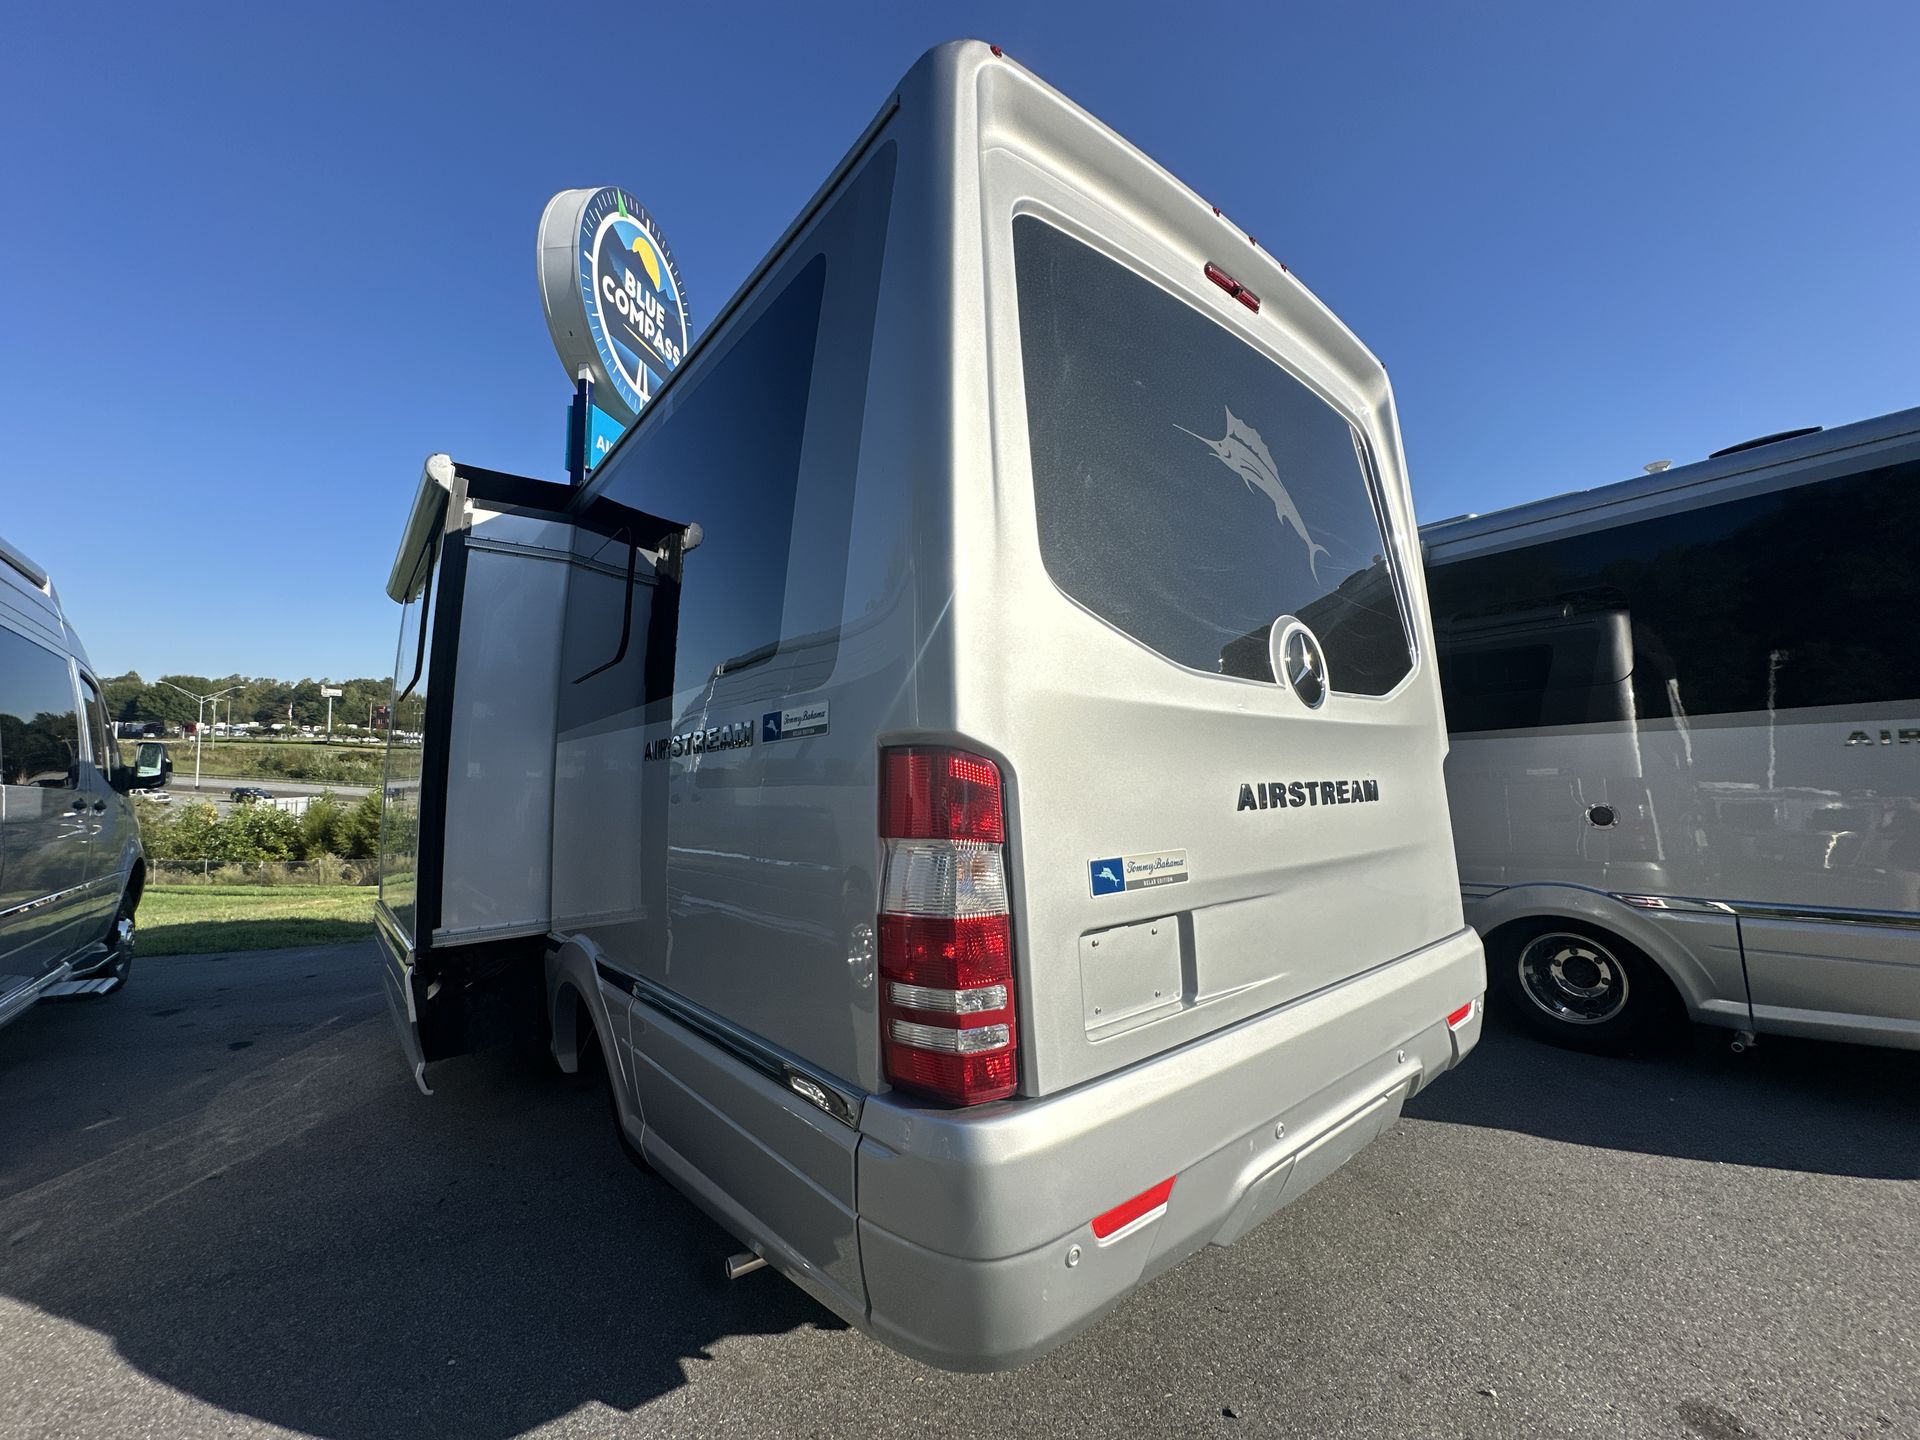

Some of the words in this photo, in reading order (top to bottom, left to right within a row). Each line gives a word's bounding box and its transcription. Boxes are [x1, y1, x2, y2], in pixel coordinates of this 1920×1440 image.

[624, 267, 666, 331] BLUE
[602, 275, 681, 368] COMPASS
[801, 709, 826, 722] Bahama
[644, 719, 755, 761] AIRSTREAM
[1236, 779, 1380, 812] AIRSTREAM
[1126, 860, 1154, 876] Tommy
[1153, 857, 1185, 870] Bahama
[1157, 876, 1174, 885] EDITION
